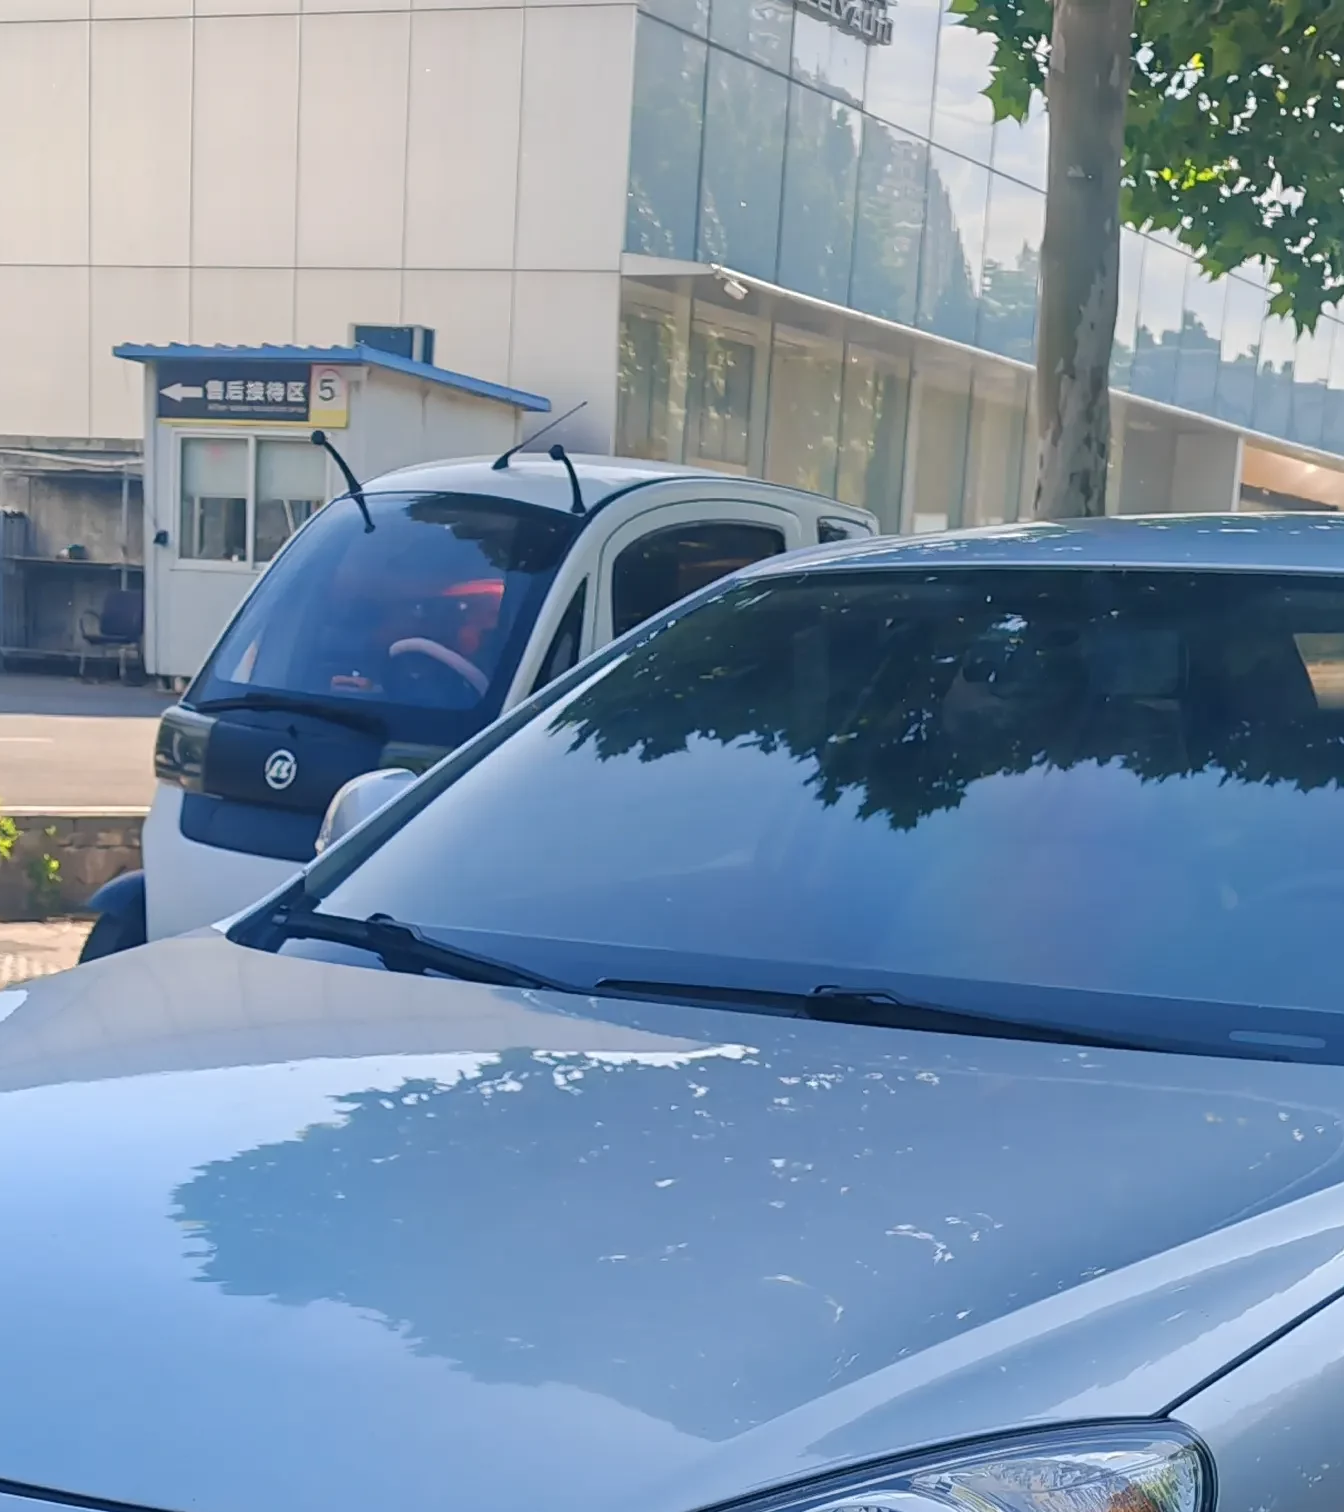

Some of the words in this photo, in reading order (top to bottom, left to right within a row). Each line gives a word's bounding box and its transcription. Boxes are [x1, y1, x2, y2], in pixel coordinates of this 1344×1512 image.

[205, 379, 306, 402] 售后接待区
[318, 378, 335, 401] 5
